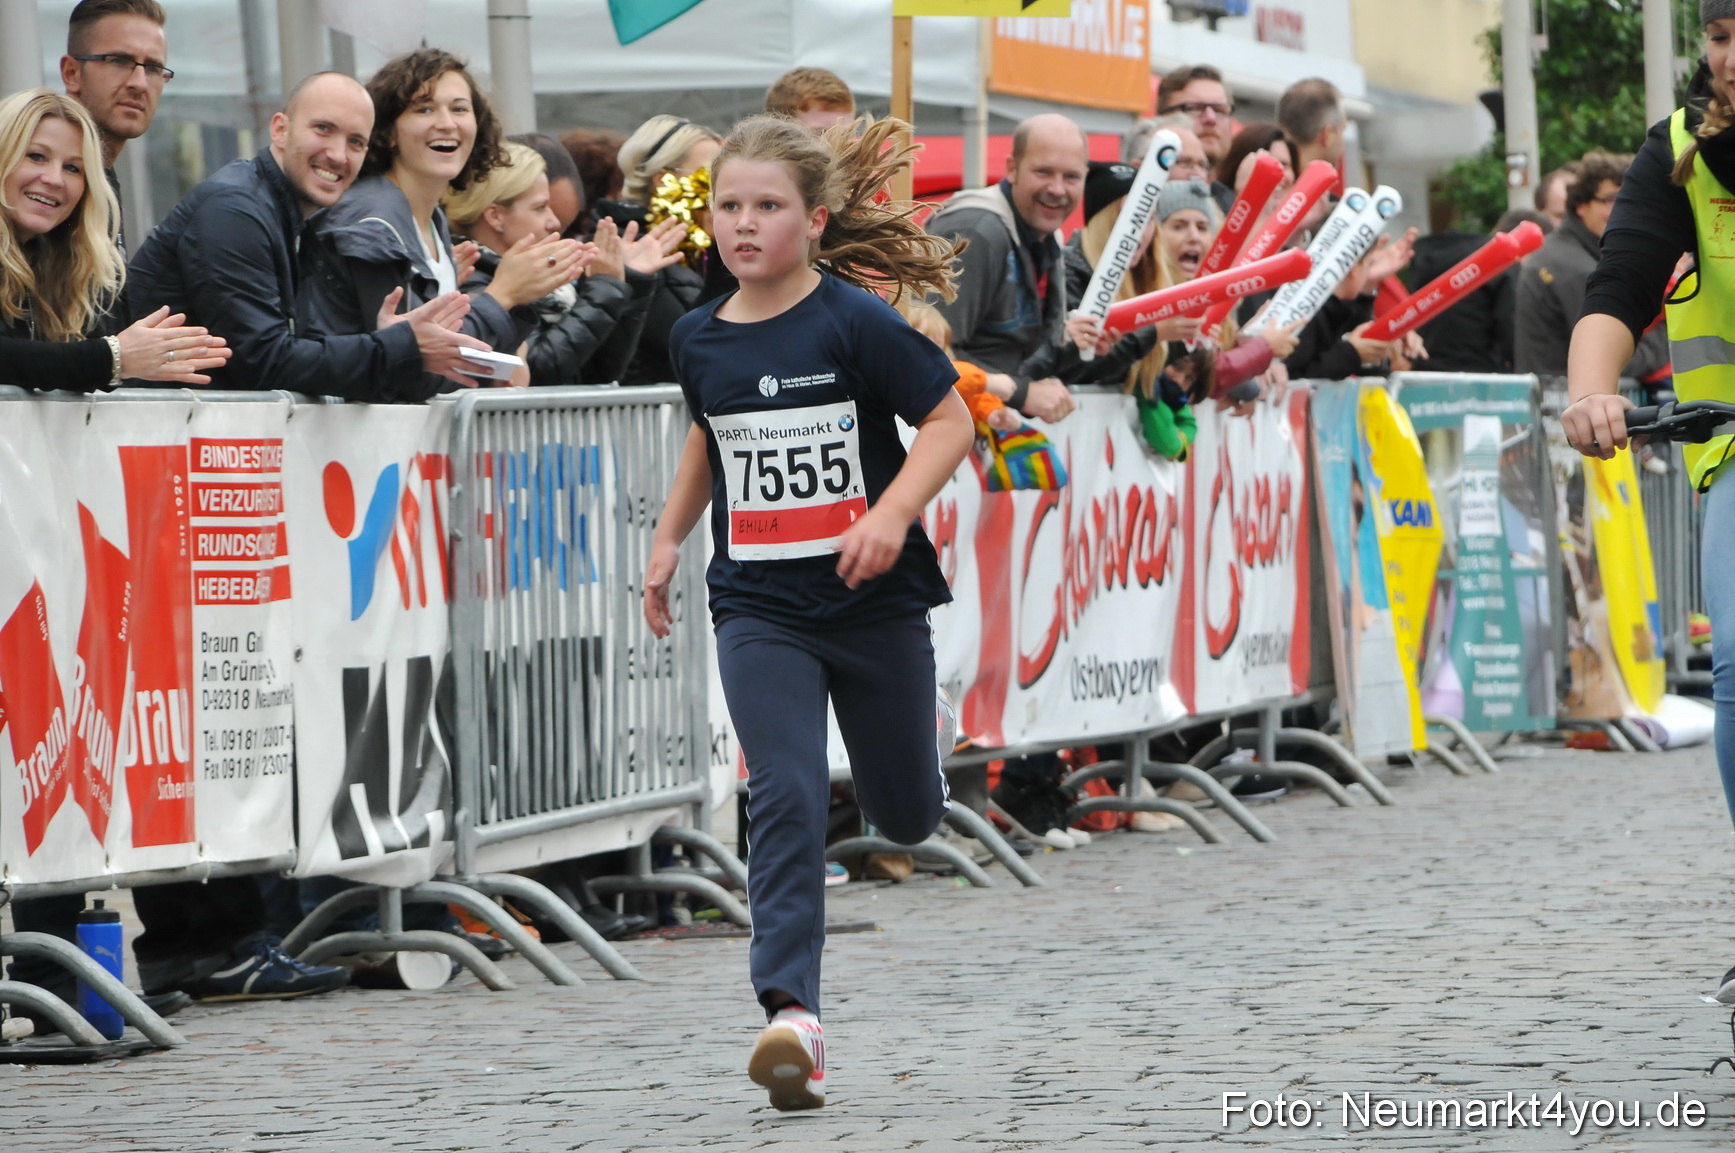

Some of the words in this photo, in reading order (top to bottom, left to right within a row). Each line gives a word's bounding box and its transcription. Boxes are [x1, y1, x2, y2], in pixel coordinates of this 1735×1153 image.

[1134, 303, 1175, 325] Audi
[1176, 292, 1213, 313] BKK
[717, 428, 757, 442] PARTL
[759, 421, 833, 440] Neumarkt
[733, 440, 851, 502] 7555
[738, 516, 779, 534] EMILIA
[201, 632, 238, 653] Braun
[202, 661, 218, 682] Am
[202, 689, 250, 711] D-92318
[16, 706, 68, 816] Braun
[204, 758, 220, 780] Fax
